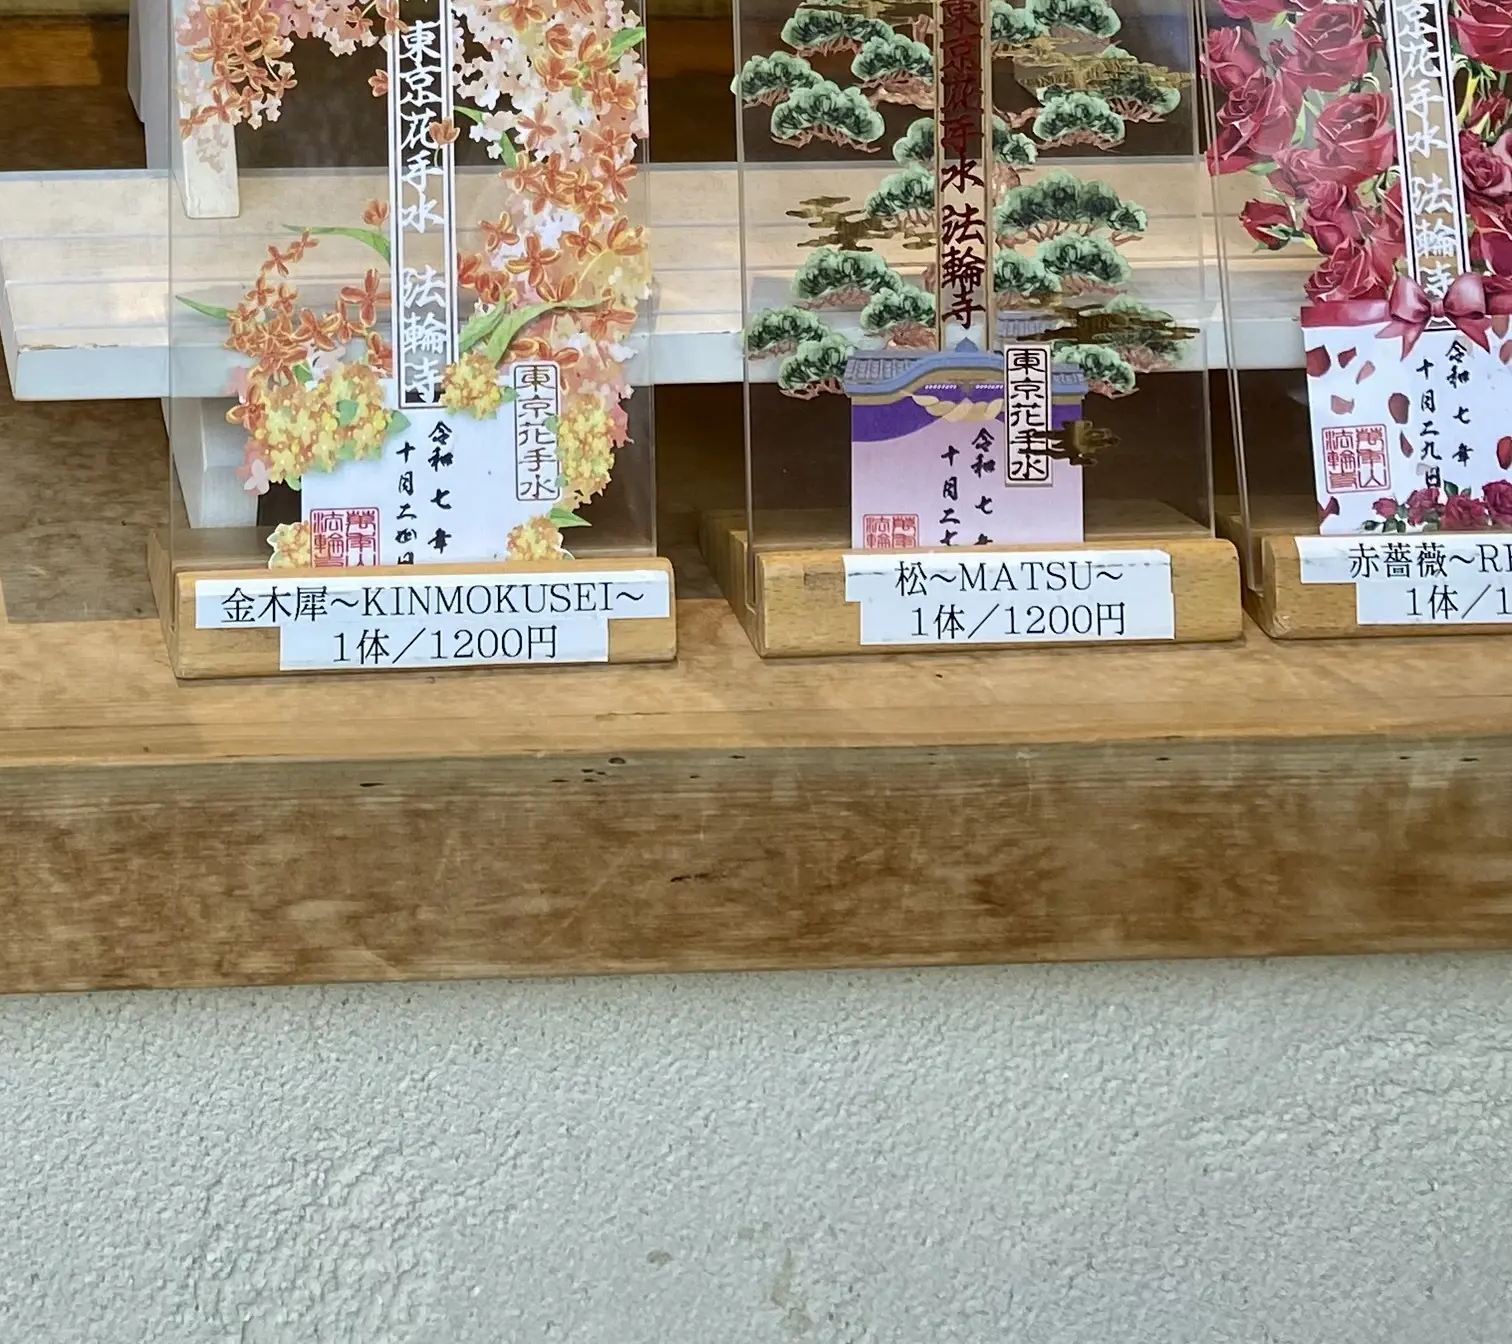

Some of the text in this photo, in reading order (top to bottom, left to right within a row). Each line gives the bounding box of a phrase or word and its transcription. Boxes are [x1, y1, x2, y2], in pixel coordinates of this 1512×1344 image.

[399, 20, 445, 230] 東京花手水
[940, 203, 986, 331] 法輪寺
[1413, 174, 1456, 294] 法輪寺
[402, 264, 447, 403] 法輪寺
[517, 363, 559, 501] 東京花手水
[330, 624, 559, 666] 1体／1200円
[909, 598, 1126, 639] 1体／1200円
